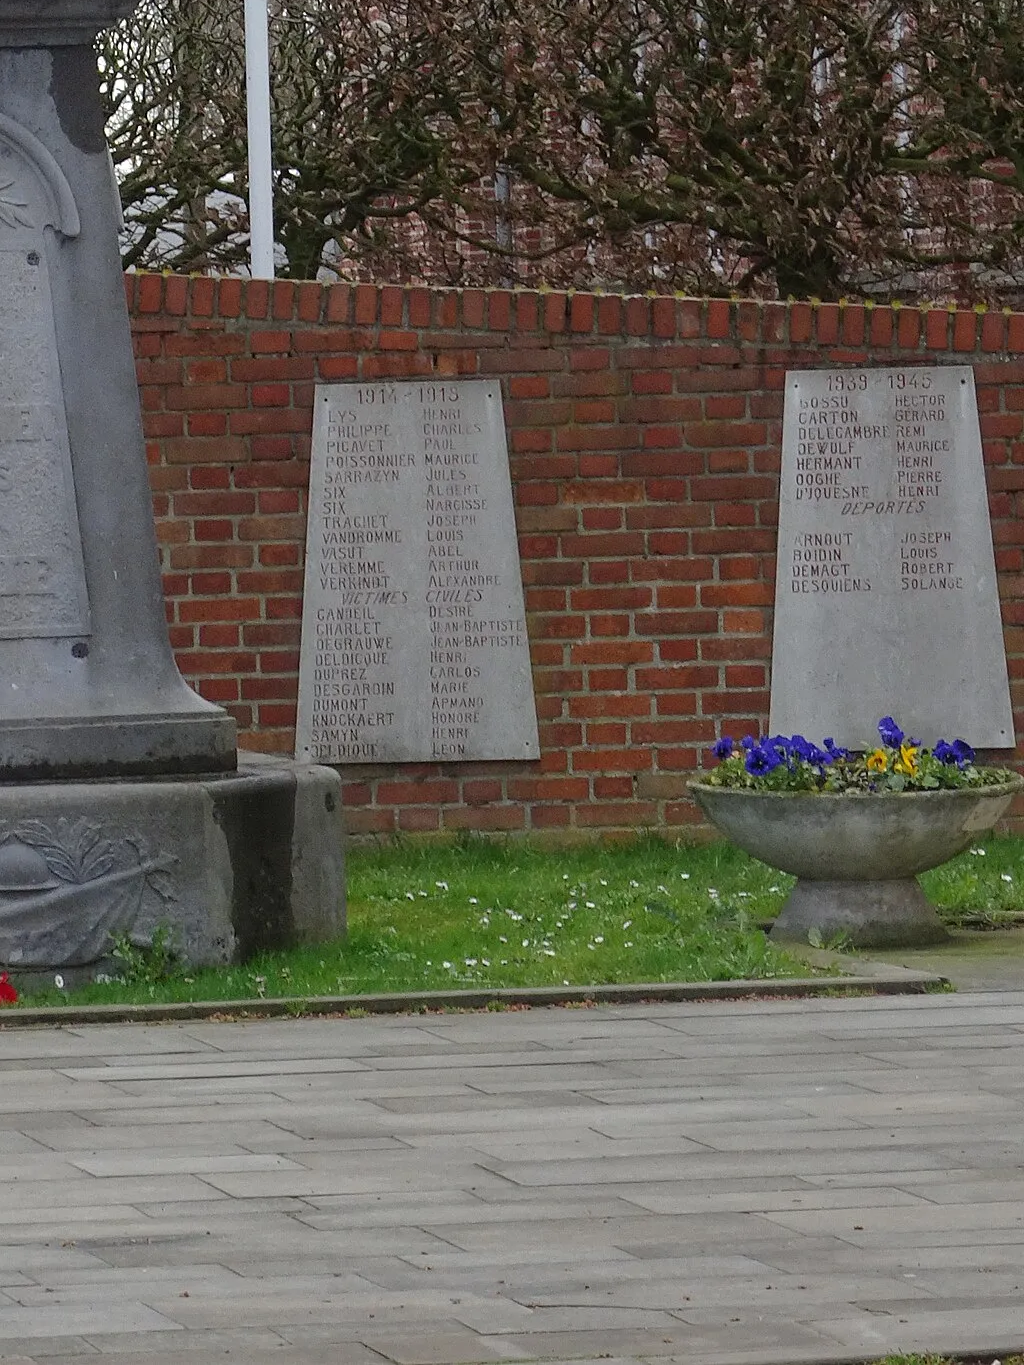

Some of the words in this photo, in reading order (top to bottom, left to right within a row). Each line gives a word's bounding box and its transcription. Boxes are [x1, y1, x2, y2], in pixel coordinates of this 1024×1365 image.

[826, 375, 868, 391] 1939
[888, 373, 932, 389] 1945
[420, 386, 459, 403] 1918
[895, 395, 945, 407] HECTOR
[328, 410, 356, 423] LYS
[422, 408, 461, 420] HENRI
[798, 411, 858, 425] CARTON
[327, 424, 392, 438] PHILIPPE
[423, 423, 482, 436] CHARLES
[326, 440, 385, 453] PICAVET
[424, 439, 457, 451] PAUL
[798, 441, 855, 456] DEWULF
[896, 440, 949, 452] MAURICE
[325, 454, 416, 468] POISSONNIER
[424, 453, 480, 466] MAURICE
[796, 456, 862, 470] HERMANT
[898, 456, 934, 468] HENRI
[324, 469, 401, 484] SARRAZYN
[425, 468, 467, 482] JULES
[898, 471, 942, 484] PIERRE
[323, 486, 346, 500] SIX
[426, 484, 480, 496] ALBERT
[898, 485, 939, 498] HENRI
[322, 502, 346, 516] SIX
[426, 498, 488, 512] NARCISSE
[426, 514, 477, 527] JOSEPH
[322, 530, 402, 544] VANDROMME
[427, 530, 464, 542] LOUIS
[900, 532, 952, 544] JOSEPH
[428, 545, 464, 558] ABEL
[793, 548, 842, 562] BOIDIN
[900, 548, 938, 559] LOUIS
[320, 560, 386, 575] VEREMME
[428, 559, 480, 572] ARTHUR
[901, 562, 954, 574] ROBERT
[429, 574, 502, 588] ALEXANDRE
[791, 579, 872, 594] DESQUIENS
[902, 578, 963, 590] SOLANGE
[342, 591, 409, 606] VICTIMES
[426, 589, 484, 604] CIVILES
[316, 622, 381, 636] CHARLET
[430, 619, 524, 634] JEAN-BAPTISTE
[316, 636, 394, 651] DEGRAUWE
[430, 634, 523, 648] JEAN-BAPTISTE
[430, 650, 467, 664] HENRI
[314, 668, 367, 682] DUPREZ
[430, 666, 481, 678] CARLOS
[431, 682, 469, 694] MARIE
[313, 698, 368, 712] DUMONT
[312, 712, 394, 727] KNOCKAERT
[312, 728, 358, 743] SAMYN
[432, 727, 470, 740] HENRI
